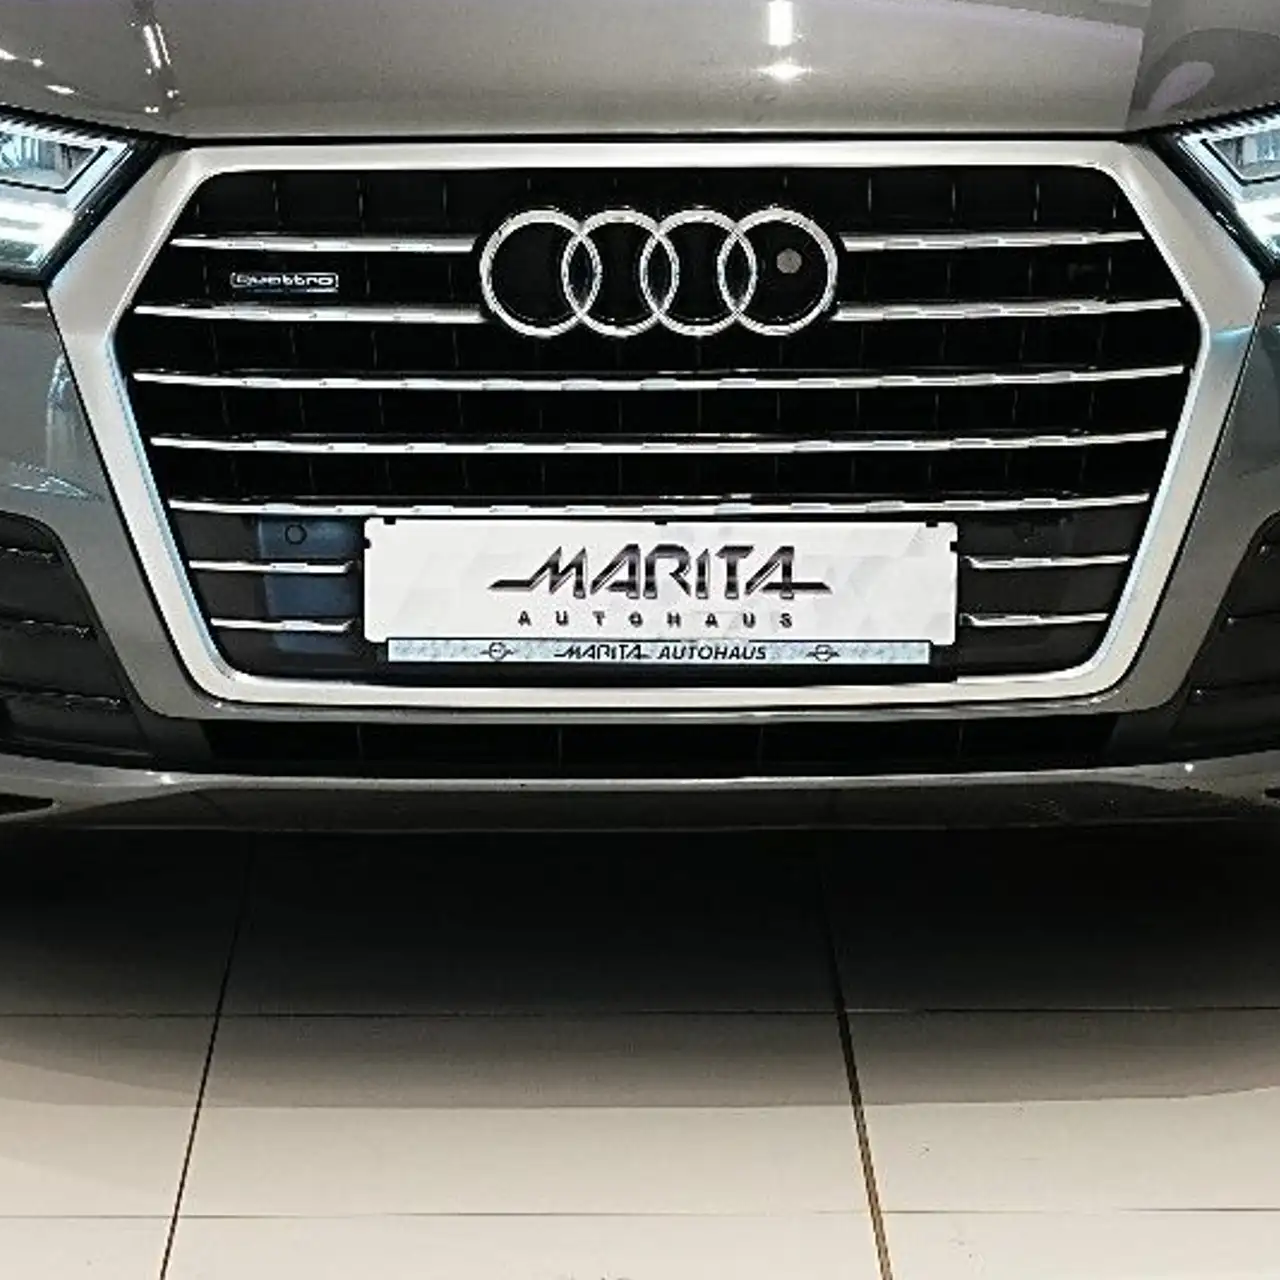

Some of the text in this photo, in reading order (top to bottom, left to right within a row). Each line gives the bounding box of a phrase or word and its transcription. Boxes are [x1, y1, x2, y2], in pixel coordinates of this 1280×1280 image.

[236, 274, 334, 287] quattro
[487, 543, 833, 600] MARITA
[517, 610, 794, 629] AUTOHAUS
[553, 644, 767, 661] MARITA AUTOHAUS
